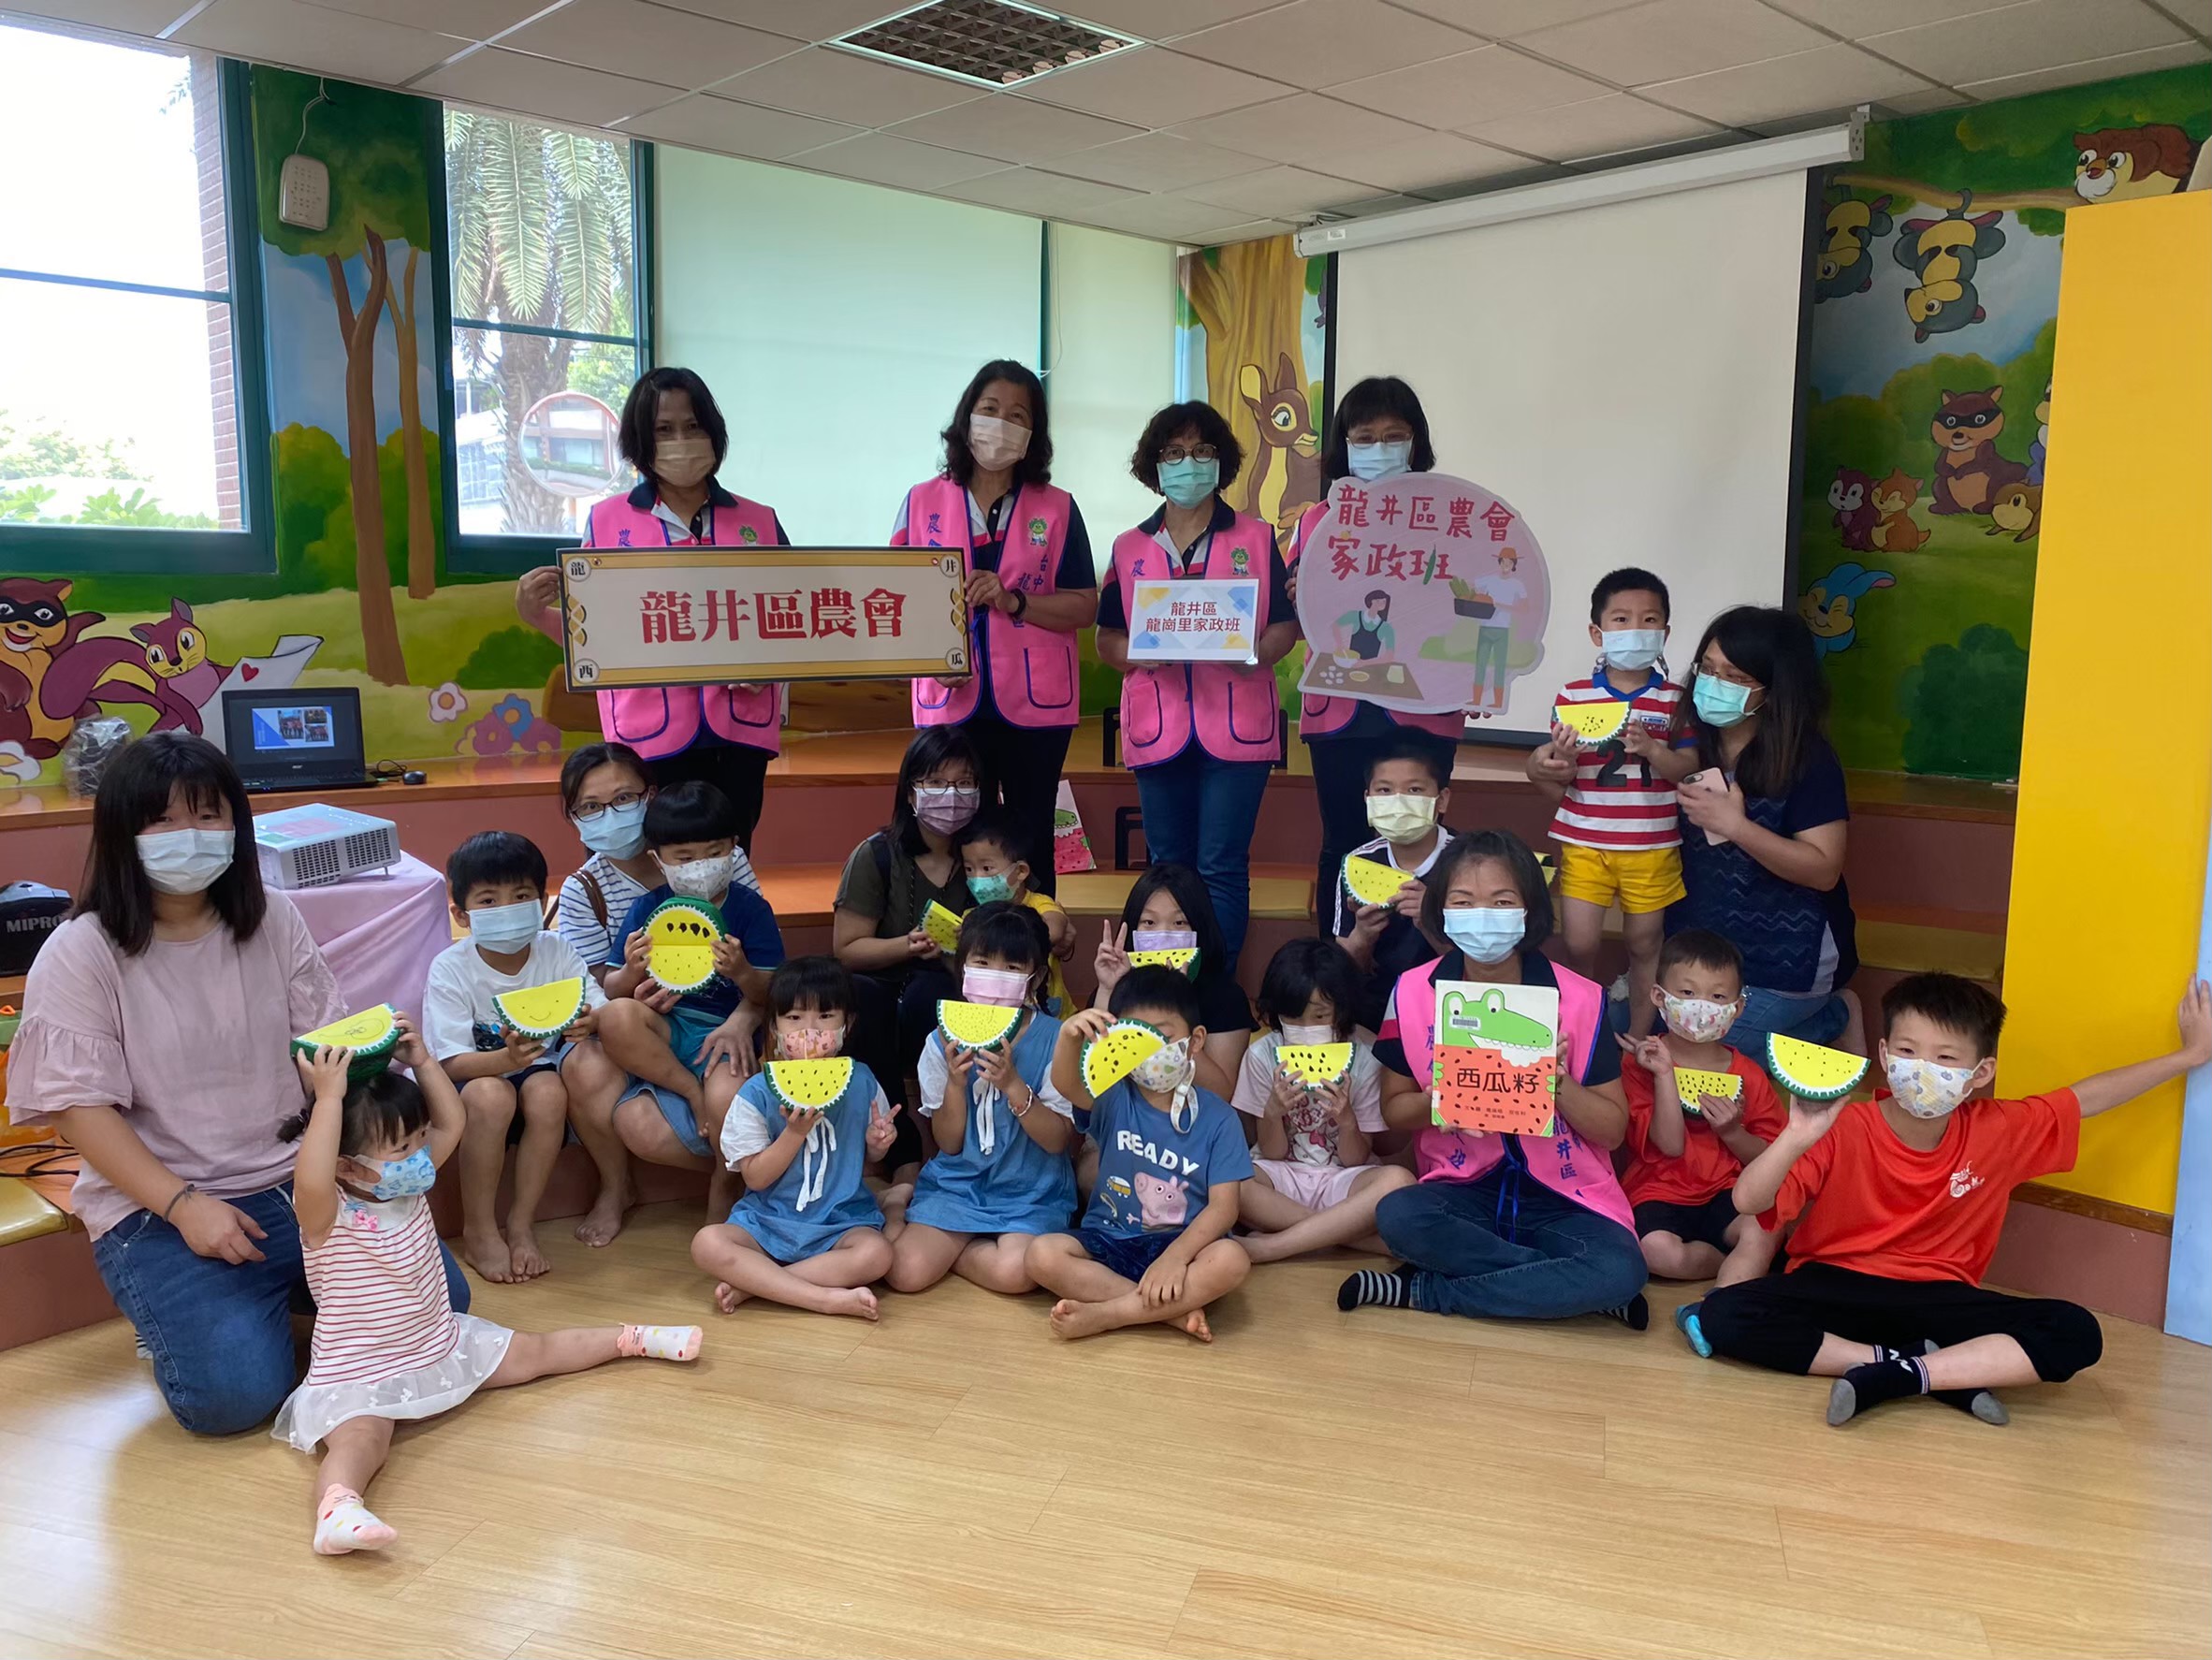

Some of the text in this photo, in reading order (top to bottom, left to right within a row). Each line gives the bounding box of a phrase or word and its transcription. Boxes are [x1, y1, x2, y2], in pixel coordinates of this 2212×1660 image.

[1337, 484, 1516, 542] 龍井區農會
[1328, 531, 1454, 585] 家政班
[639, 588, 908, 645] 龍井區農會
[1171, 601, 1217, 617] 龍井區
[1456, 1067, 1540, 1094] 西瓜籽
[1116, 1129, 1200, 1176] READY
